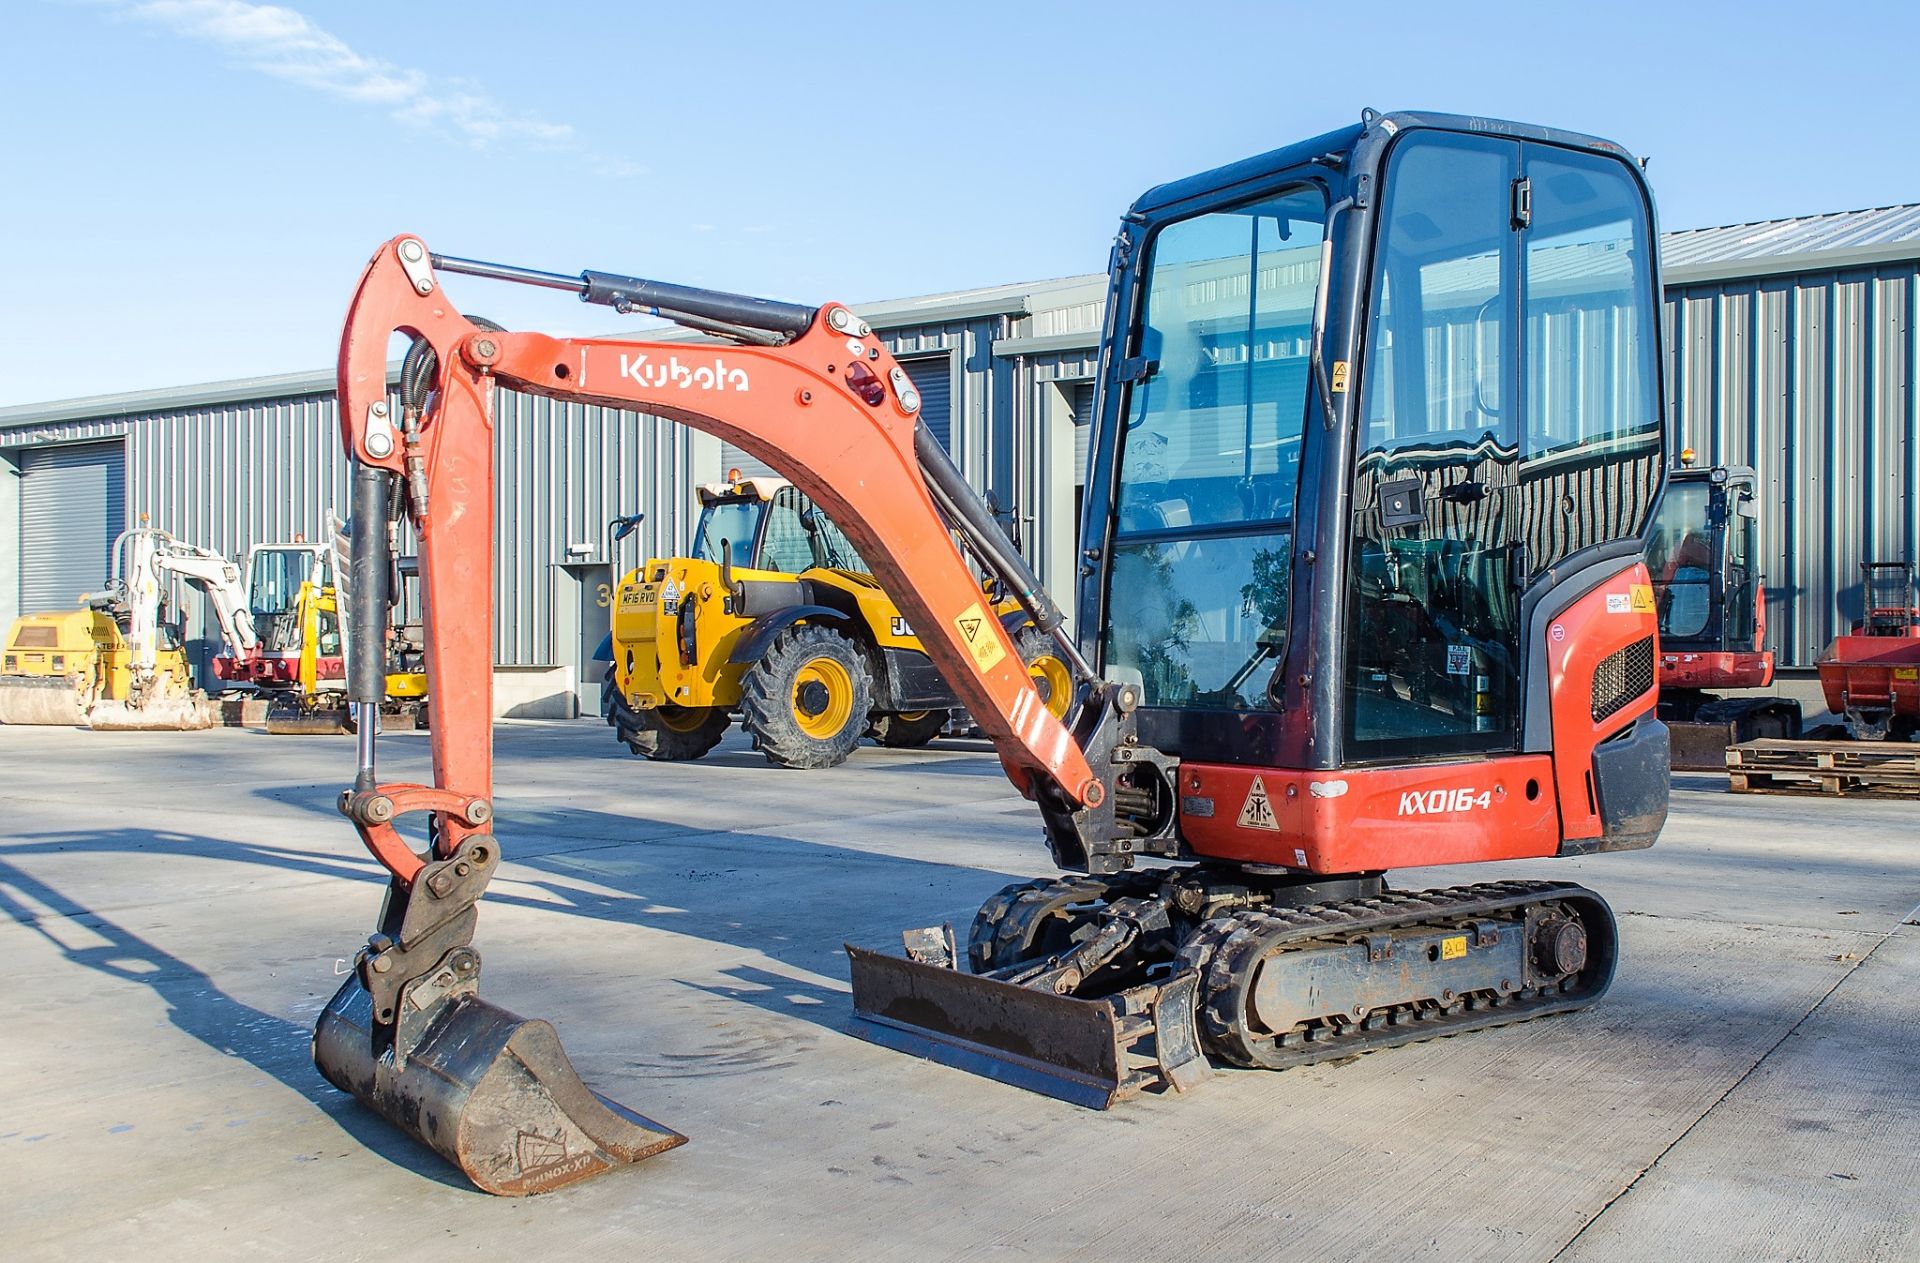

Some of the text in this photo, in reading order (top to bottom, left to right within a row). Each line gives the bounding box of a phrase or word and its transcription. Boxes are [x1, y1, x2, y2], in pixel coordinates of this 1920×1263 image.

[620, 354, 749, 392] Kubota
[596, 583, 611, 608] 3
[1398, 787, 1491, 816] KX016-4
